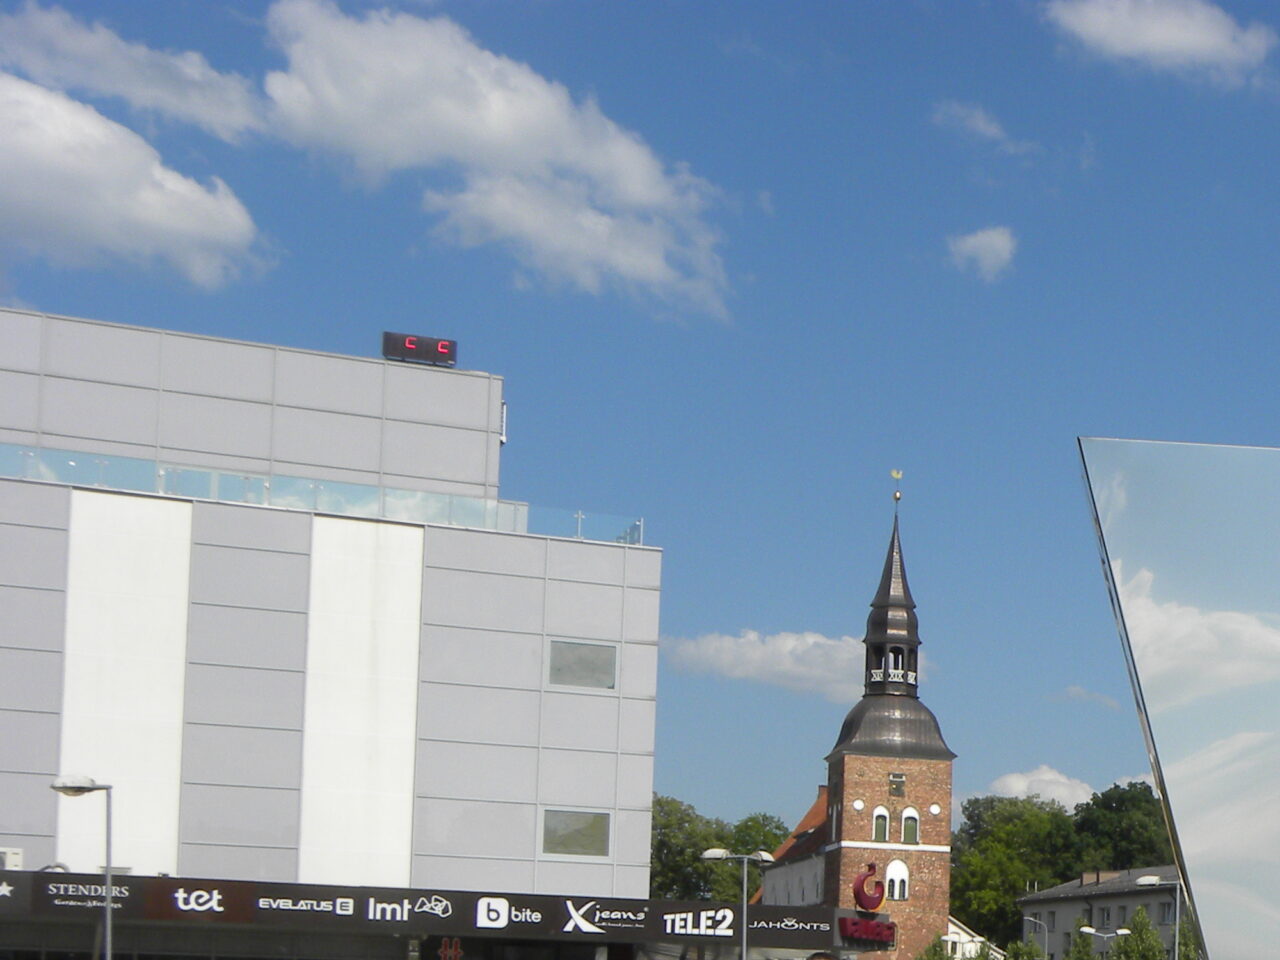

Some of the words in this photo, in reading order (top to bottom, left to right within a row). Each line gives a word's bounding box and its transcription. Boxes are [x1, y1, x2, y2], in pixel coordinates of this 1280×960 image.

[48, 883, 130, 897] STENDERS
[174, 887, 225, 912] tet
[258, 898, 333, 912] EVELATUS
[511, 906, 542, 923] bite
[663, 908, 735, 937] TELE2
[748, 917, 831, 931] JAHONTS
